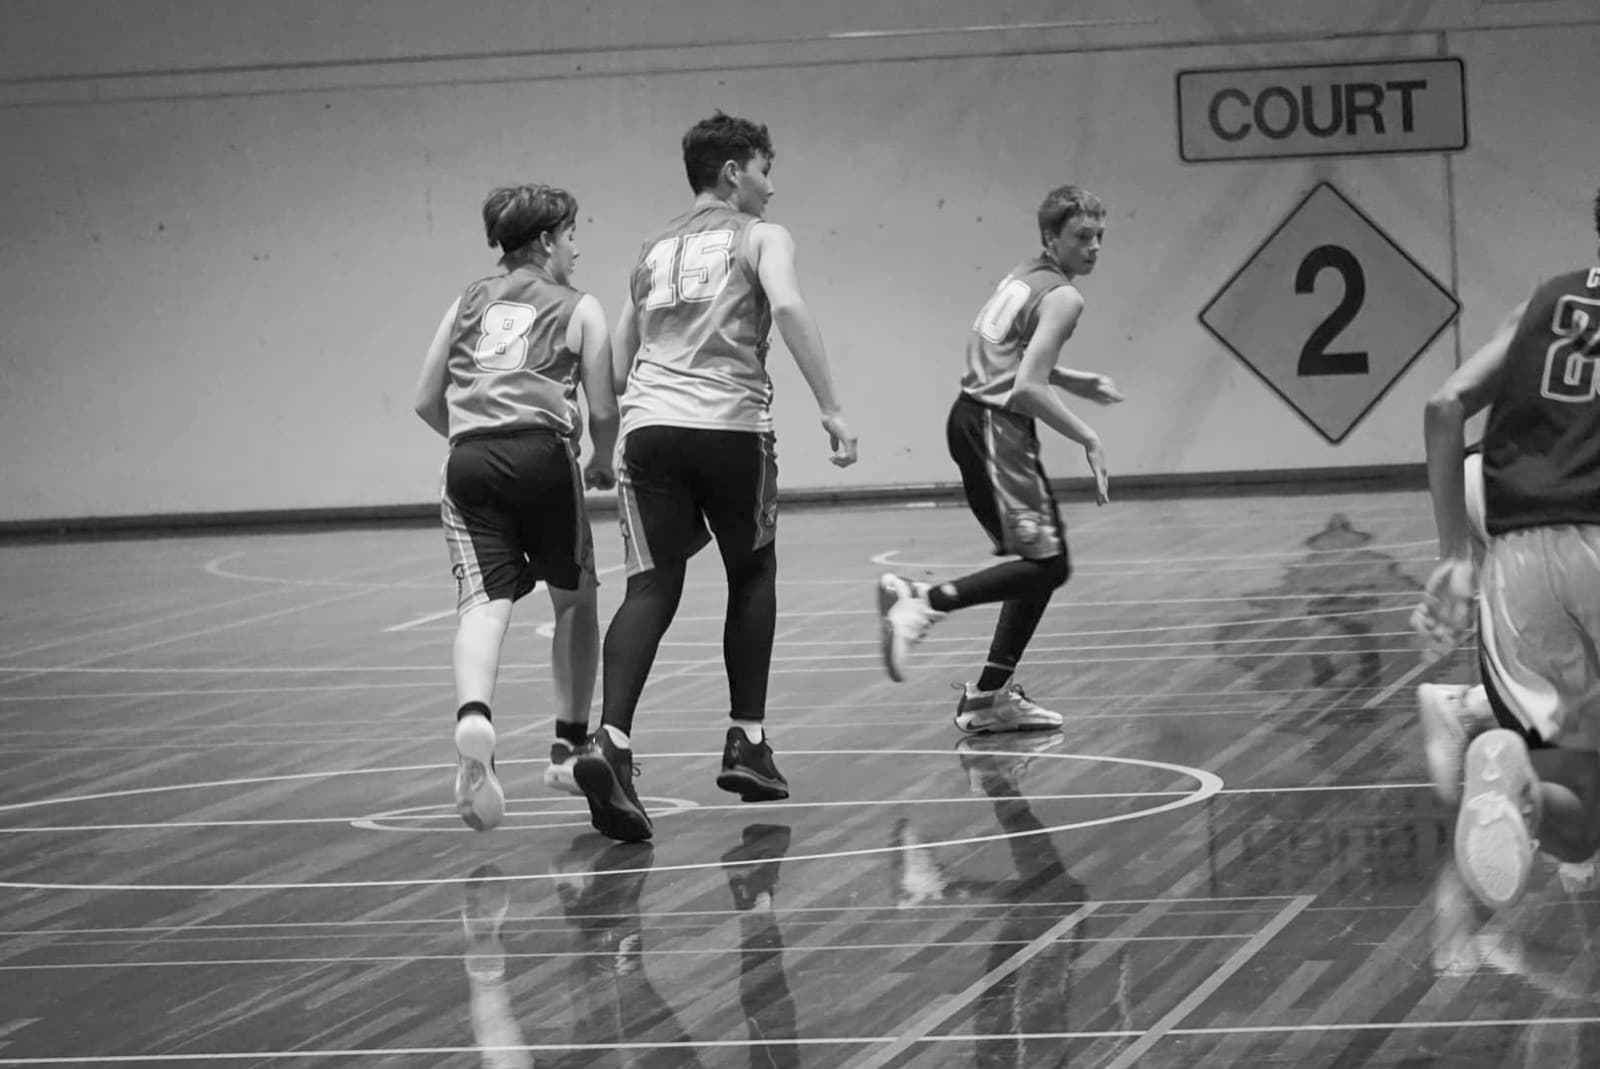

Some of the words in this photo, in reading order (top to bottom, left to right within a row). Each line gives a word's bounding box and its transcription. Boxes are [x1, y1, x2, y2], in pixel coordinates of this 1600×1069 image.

[1208, 80, 1427, 141] COURT
[646, 231, 734, 310] 15
[475, 301, 537, 372] 8
[974, 275, 1031, 343] 0
[1295, 244, 1369, 377] 2
[1540, 294, 1600, 402] 2
